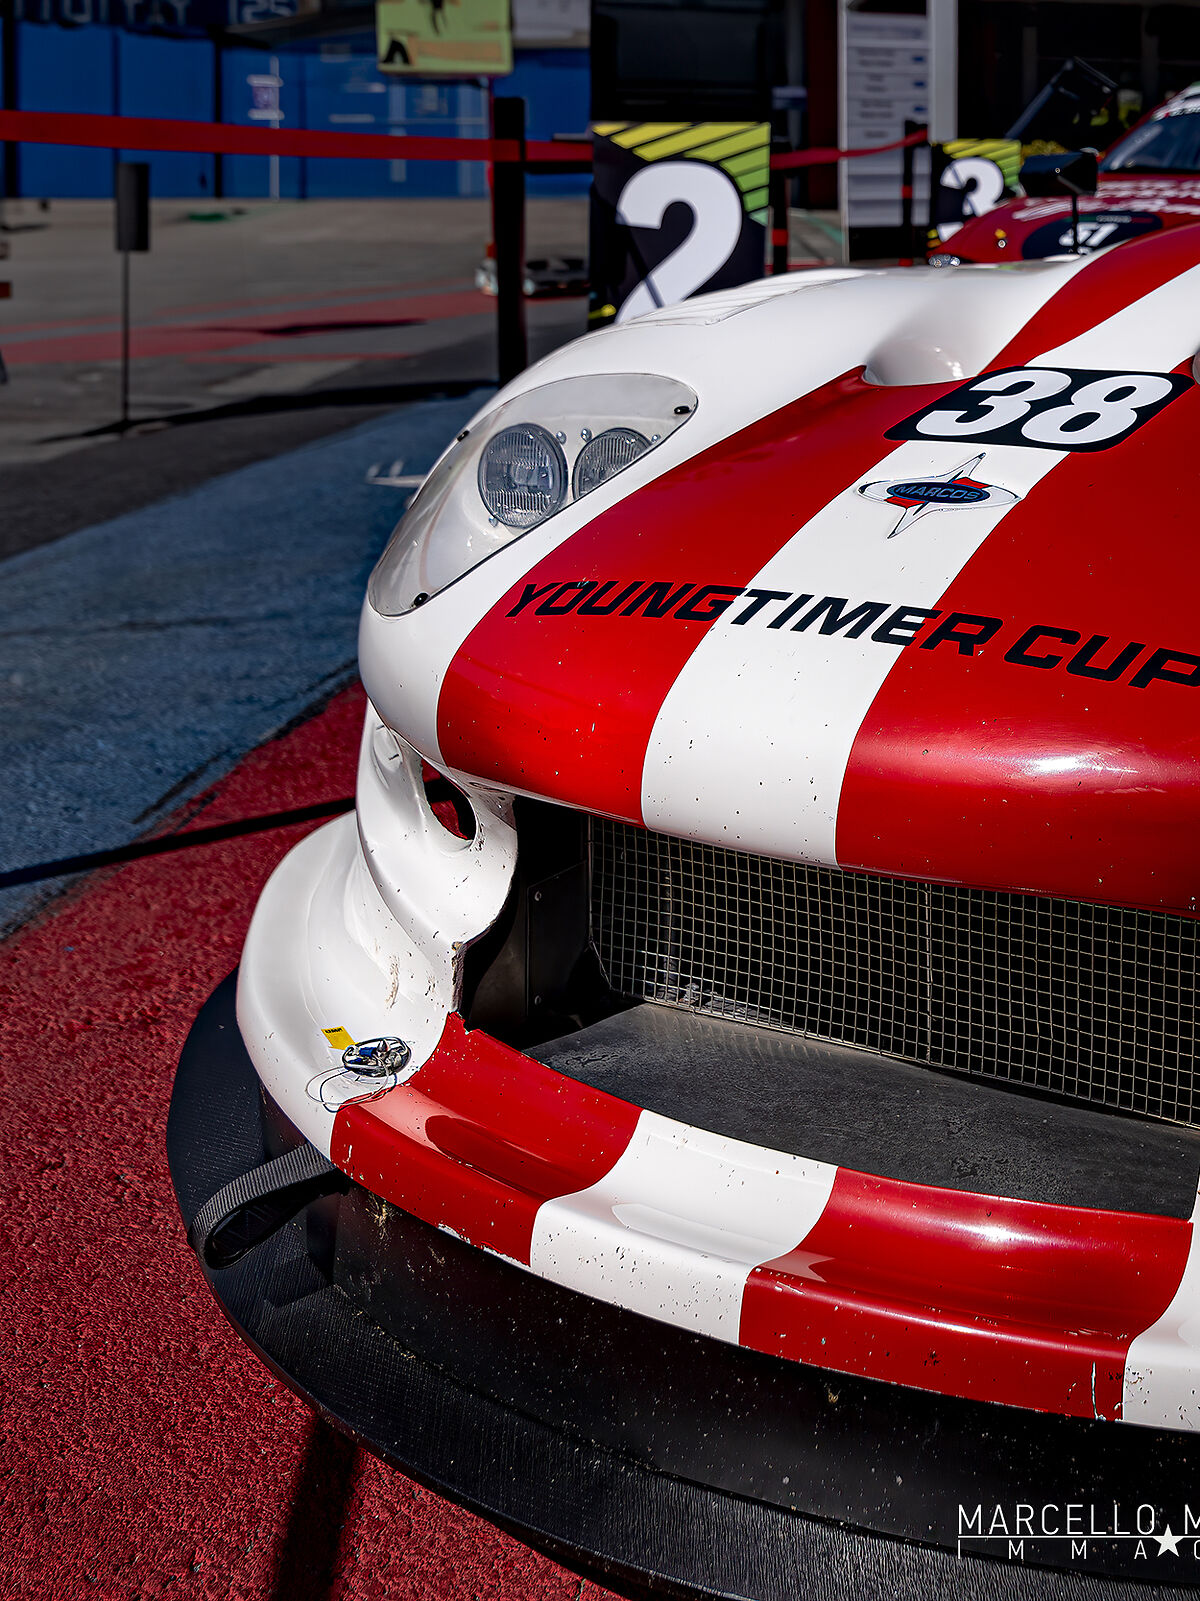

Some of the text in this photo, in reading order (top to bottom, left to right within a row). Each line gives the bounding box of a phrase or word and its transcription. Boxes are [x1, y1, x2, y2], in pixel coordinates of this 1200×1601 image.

[936, 156, 1004, 241] 3
[614, 160, 743, 325] 2
[916, 365, 1166, 446] 38
[895, 484, 982, 500] MARCOS
[505, 580, 1004, 657] YOUNGTIMER
